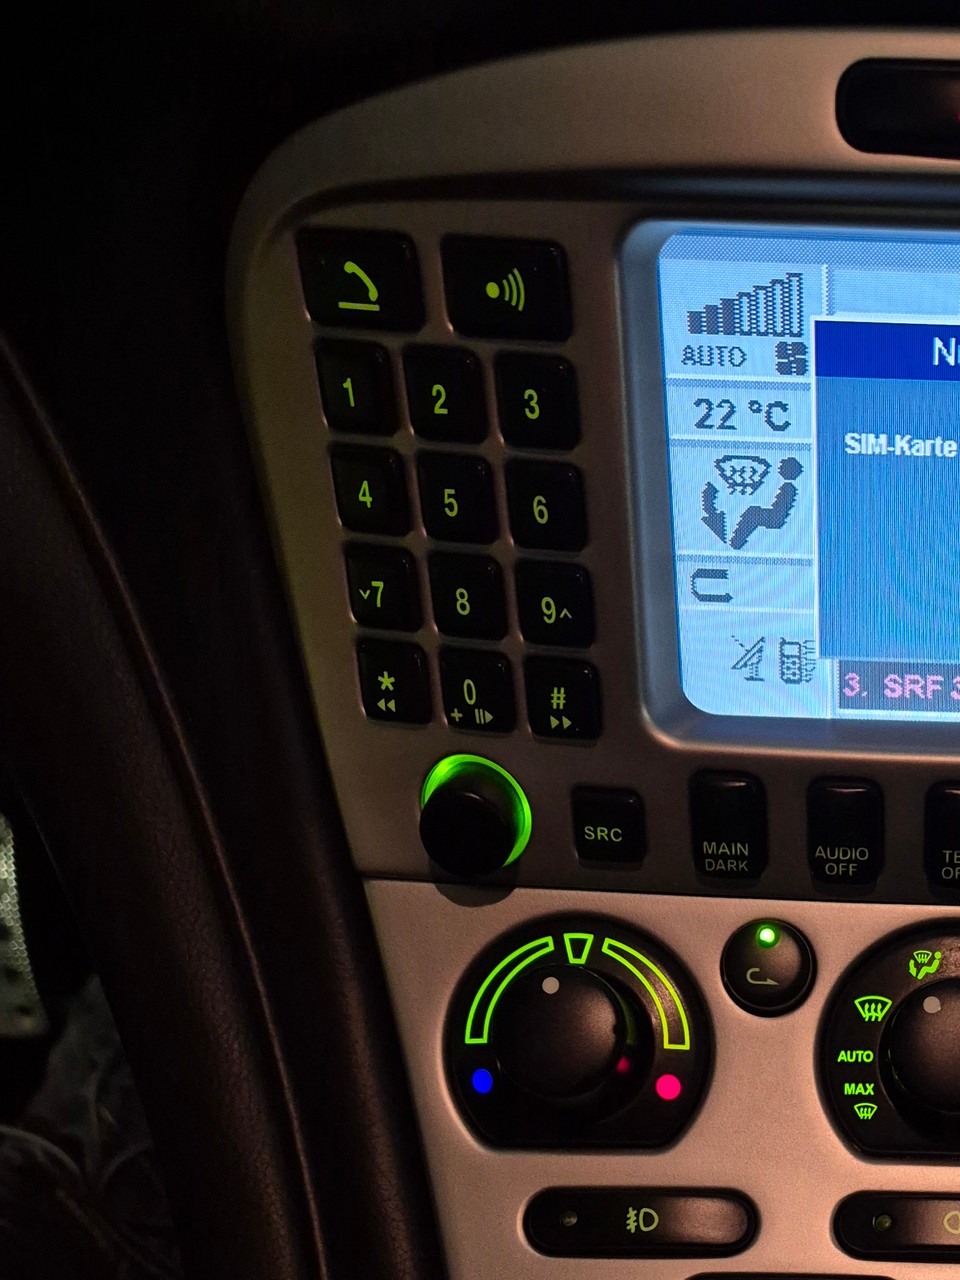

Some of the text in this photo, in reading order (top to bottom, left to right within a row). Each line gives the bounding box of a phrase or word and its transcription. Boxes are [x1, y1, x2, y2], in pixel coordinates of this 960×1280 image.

[681, 344, 747, 368] AUTO
[342, 376, 357, 408] 1
[431, 383, 449, 415] 2
[523, 388, 541, 420] 3
[692, 397, 792, 433] 22 °C
[844, 432, 958, 458] SIM-Karte
[357, 479, 373, 509] 4
[443, 488, 459, 517] 5
[532, 495, 549, 525] 6
[454, 587, 471, 616] 8
[462, 678, 477, 705] 0
[842, 672, 868, 698] 3.
[883, 673, 945, 700] SRF
[584, 825, 623, 843] SRC
[703, 841, 749, 858] MAIN
[814, 845, 870, 862] AUDIO
[704, 858, 749, 873] DARK
[824, 862, 859, 877] OFF
[837, 1050, 875, 1063] AUTO
[844, 1083, 875, 1096] MAX
